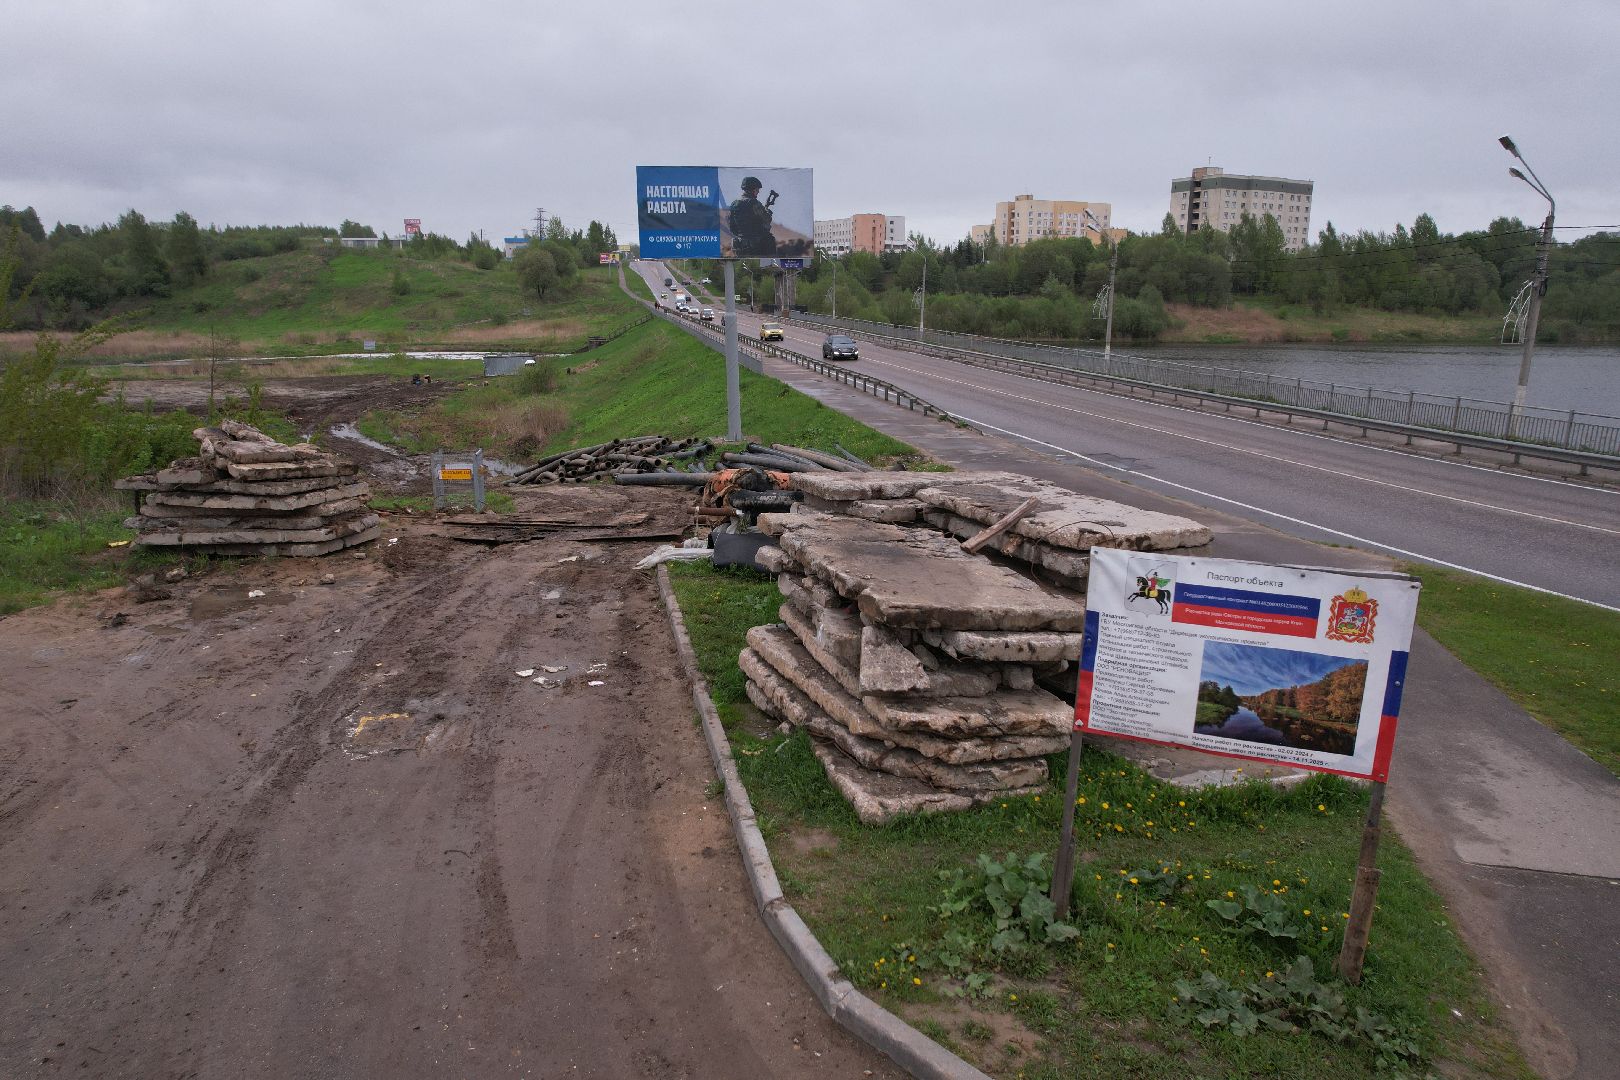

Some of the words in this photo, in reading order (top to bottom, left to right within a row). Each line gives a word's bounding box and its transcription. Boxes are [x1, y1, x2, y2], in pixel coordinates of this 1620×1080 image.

[646, 185, 709, 198] НАСТОЯЩАЯ
[647, 201, 687, 213] РАБОТА
[1206, 571, 1244, 584] Паспорт
[1246, 576, 1284, 587] объекта
